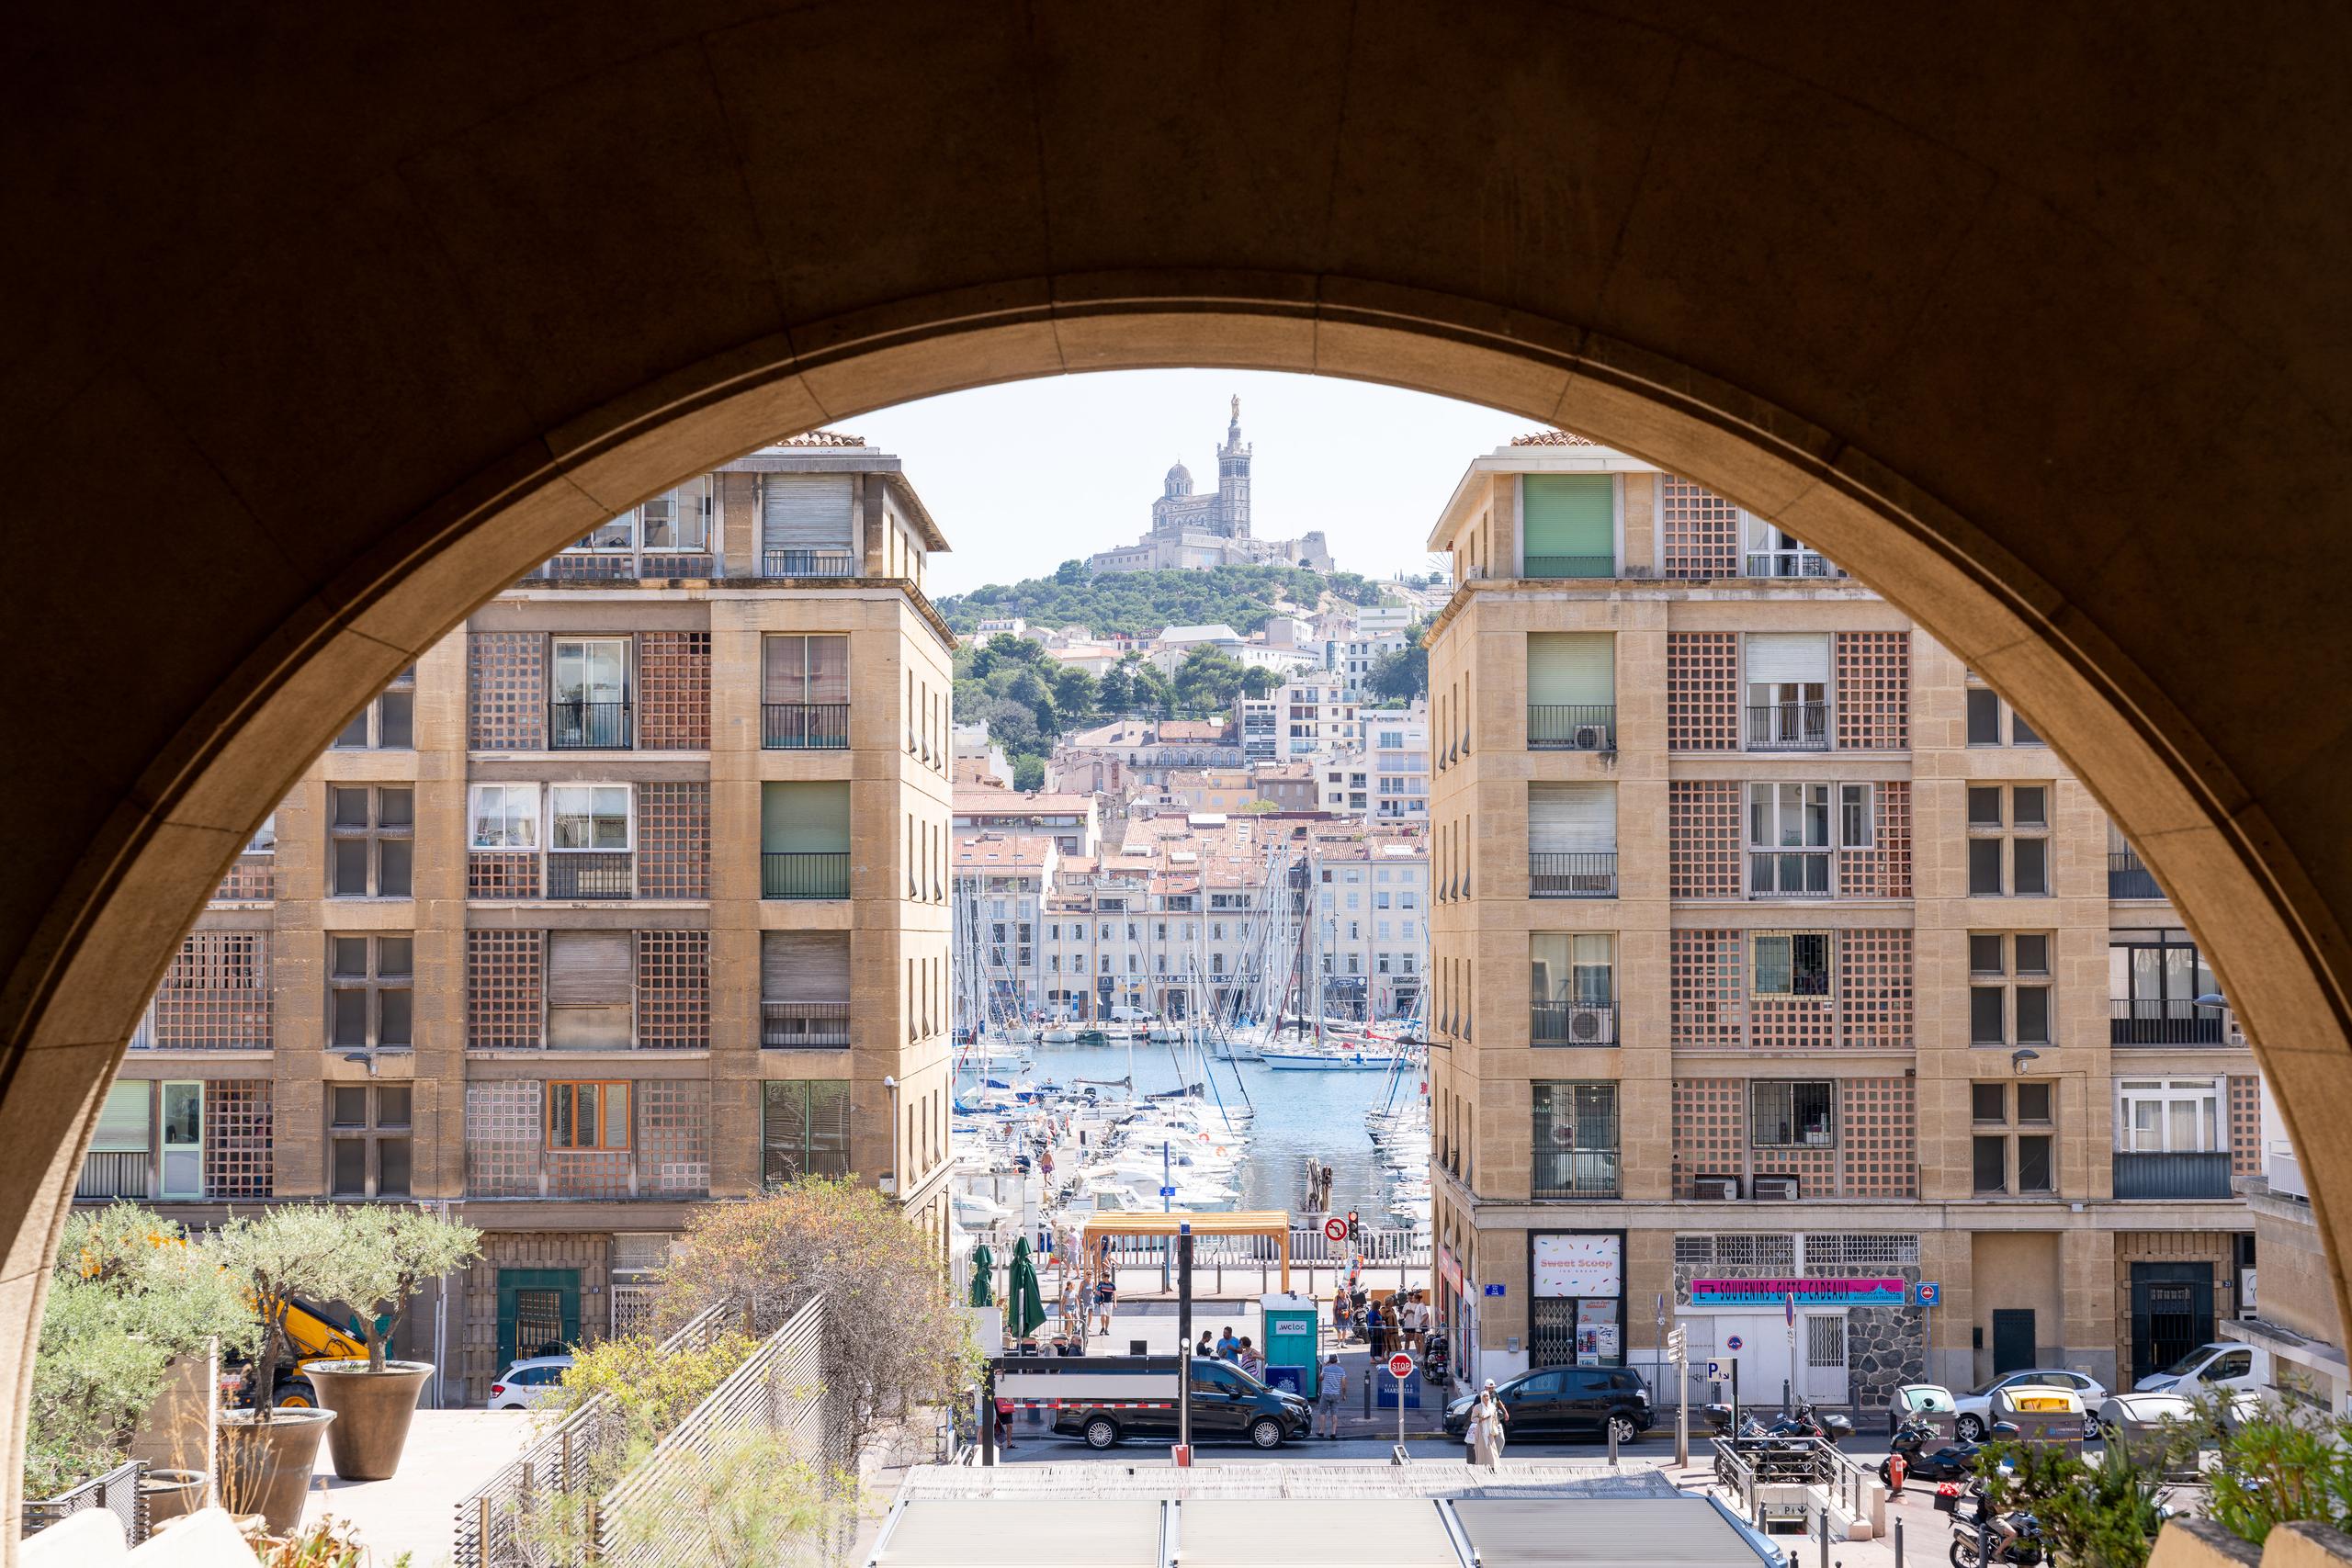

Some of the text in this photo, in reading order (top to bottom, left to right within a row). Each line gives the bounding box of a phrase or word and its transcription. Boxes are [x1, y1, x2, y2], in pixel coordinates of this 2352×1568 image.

[1541, 1258, 1612, 1269] Sweet Scoop
[1709, 1363, 1718, 1378] P
